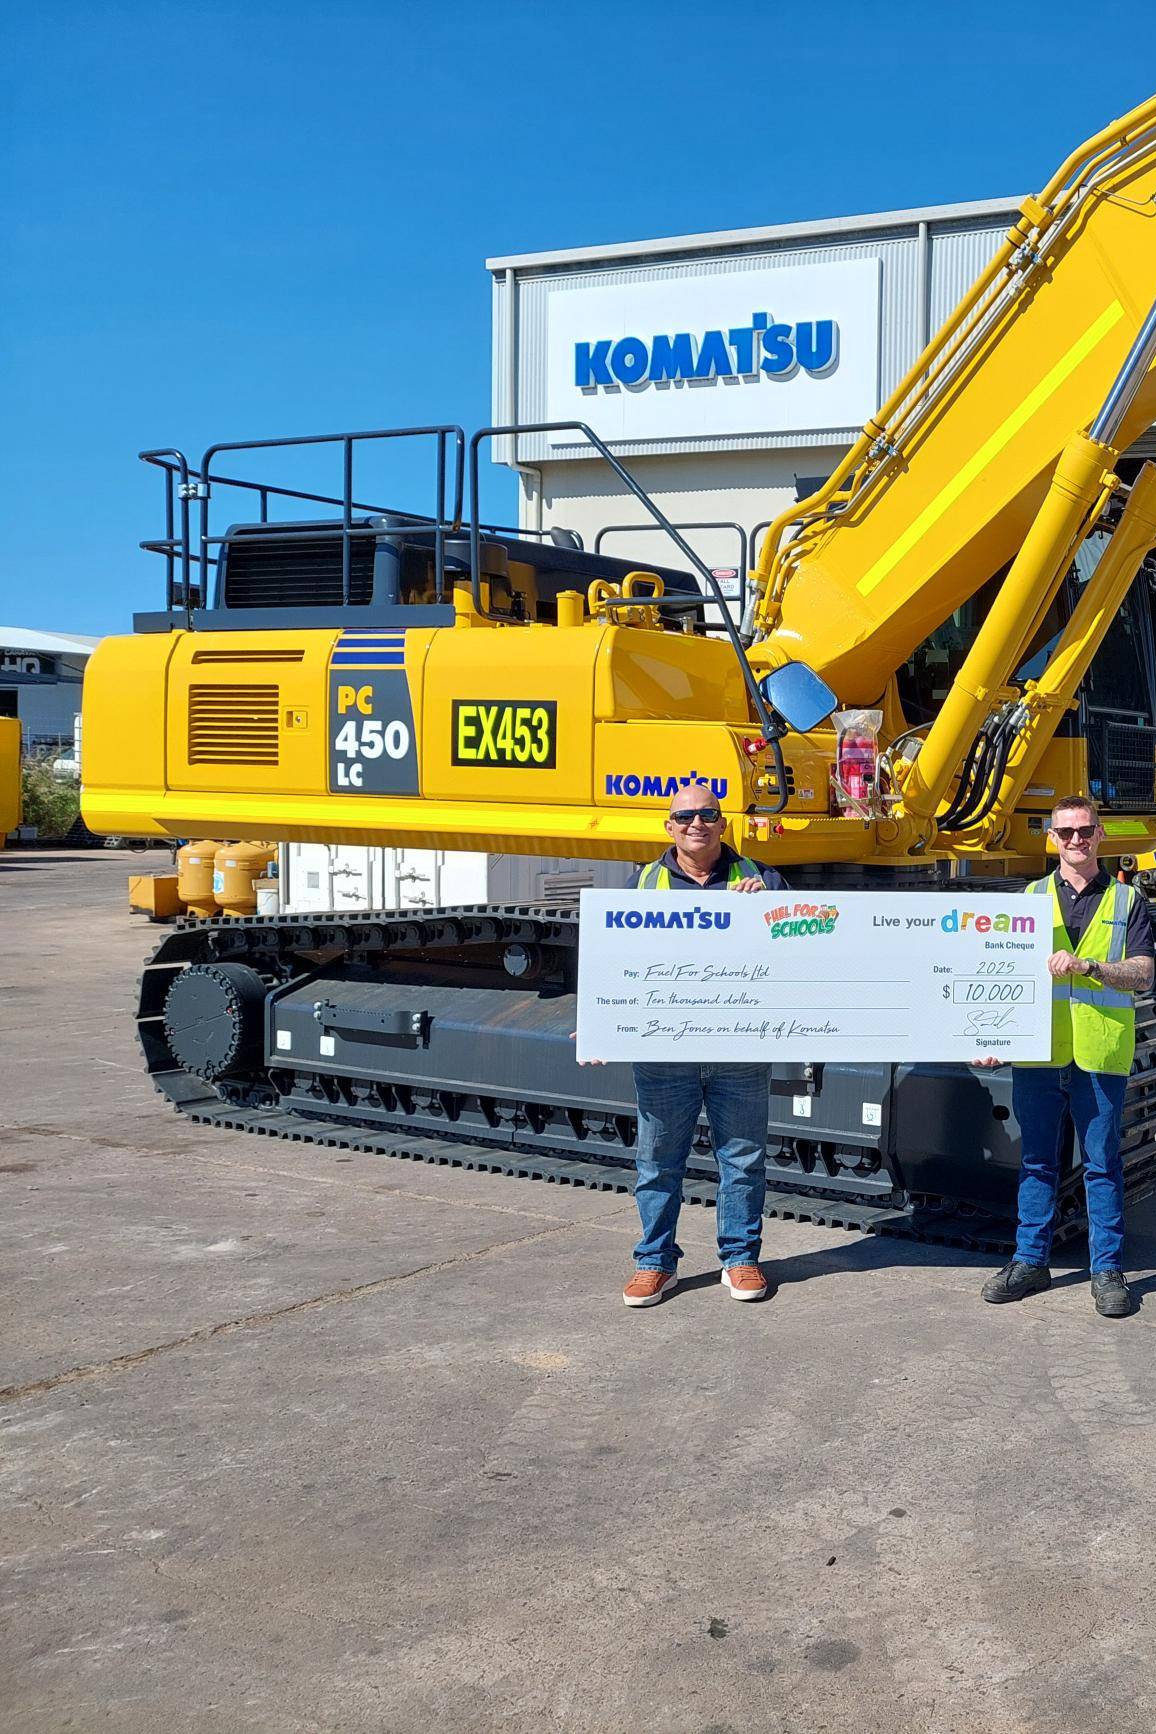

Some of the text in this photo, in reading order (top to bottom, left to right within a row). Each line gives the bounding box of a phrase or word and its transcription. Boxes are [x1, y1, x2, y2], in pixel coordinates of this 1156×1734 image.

[575, 312, 837, 390] KOMATSU
[337, 686, 373, 714] PC
[335, 720, 409, 759] 450
[457, 705, 550, 763] EX453
[337, 763, 363, 787] LC
[605, 907, 731, 929] KOMATSU
[763, 904, 819, 926] FUEL FOR
[872, 909, 1035, 933] Live your dream
[771, 917, 836, 939] SCHOOLS
[985, 941, 1035, 951] Bank Cheque
[623, 969, 640, 979] Pay:
[644, 964, 770, 981] Fuel For Schools Ltd
[933, 965, 953, 974] Date:
[975, 961, 1016, 974] 2025
[596, 997, 610, 1005] The
[629, 997, 639, 1005] of:
[645, 990, 760, 1006] Ten thousand dollars
[942, 984, 951, 999] $
[616, 1025, 638, 1033] From:
[641, 1020, 840, 1041] Ben Jones on behalf of Komatsu
[976, 1038, 1011, 1047] Signature
